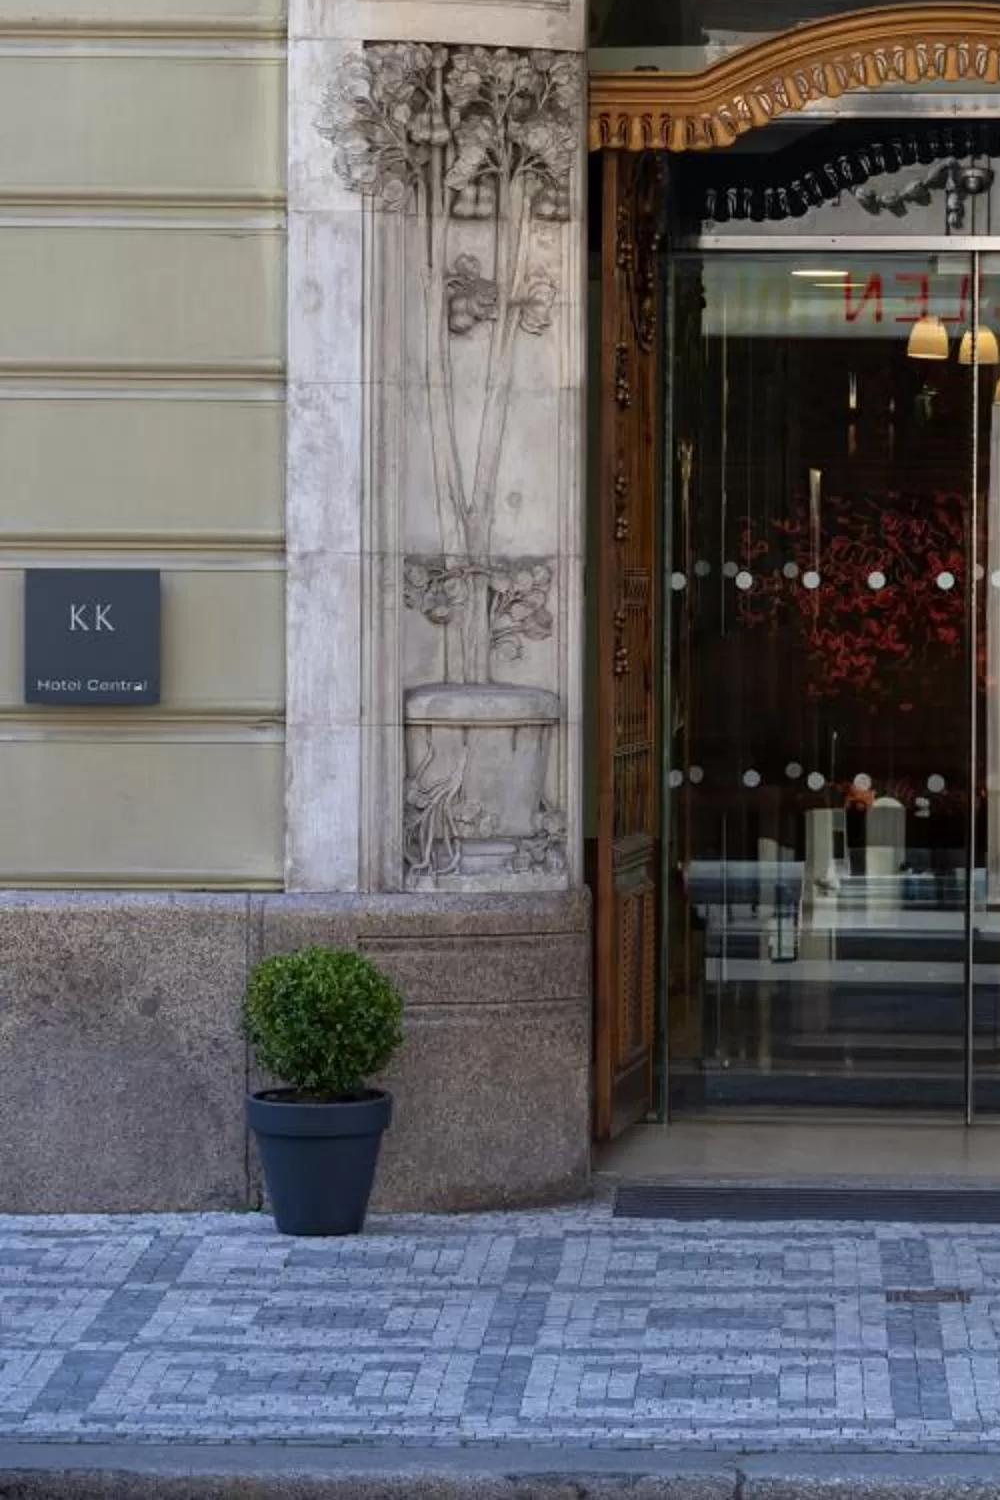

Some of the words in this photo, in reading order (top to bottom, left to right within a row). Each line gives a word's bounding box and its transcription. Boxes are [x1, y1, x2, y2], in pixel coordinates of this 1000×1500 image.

[69, 603, 116, 631] KK
[37, 679, 82, 692] Hotel
[87, 679, 149, 692] Central
